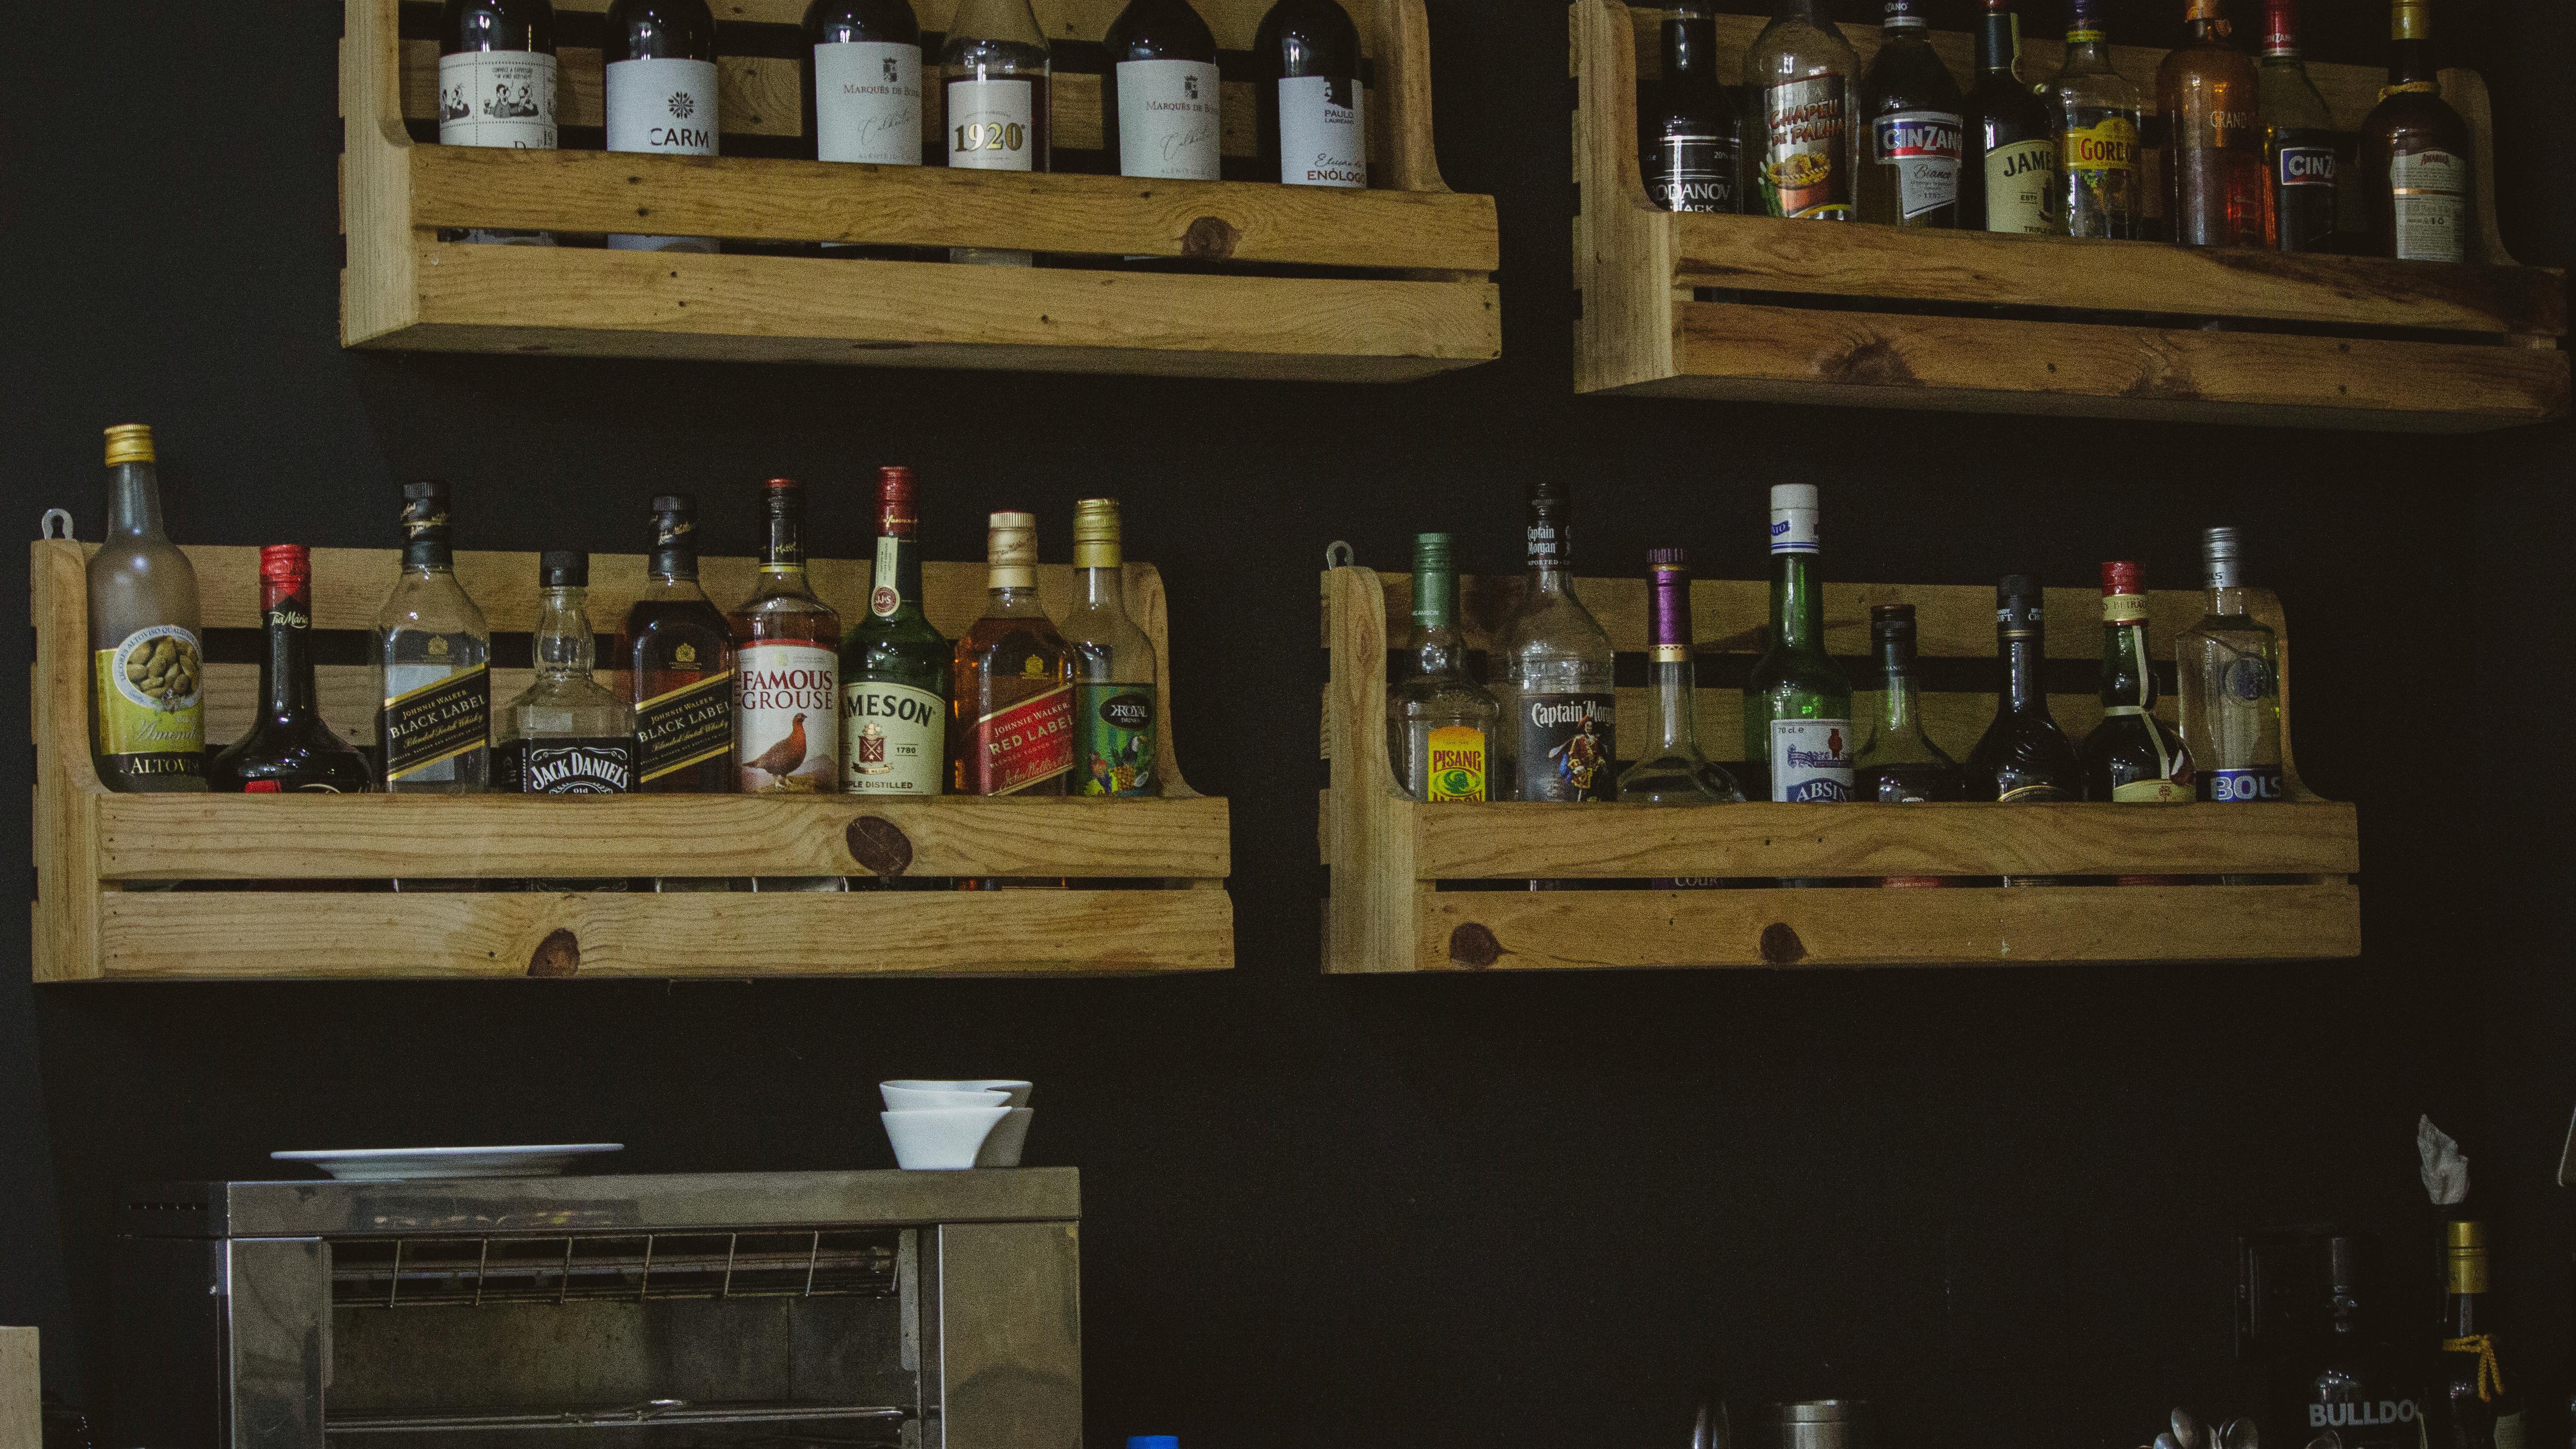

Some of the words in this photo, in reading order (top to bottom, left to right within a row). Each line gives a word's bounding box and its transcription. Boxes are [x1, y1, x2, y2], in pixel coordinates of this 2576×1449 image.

[1324, 110, 1354, 118] PAULO
[650, 128, 709, 148] CARM
[954, 122, 1023, 153] 1920
[1527, 525, 1555, 542] Captain
[1527, 541, 1556, 557] Morgan
[741, 670, 833, 690] FAMOUS
[402, 701, 436, 720] JOHNNIE
[436, 689, 468, 705] WALKER
[651, 706, 684, 724] JOHNNIE
[684, 696, 715, 711] WALKER
[741, 691, 832, 710] GROUSE
[389, 712, 439, 739] BLACK
[441, 694, 485, 719] LABEL
[638, 717, 686, 743] BLACK
[690, 701, 730, 725] LABEL
[994, 715, 1033, 738] JOHNNIE
[1033, 702, 1068, 721] WALKER
[1531, 701, 1583, 728] Captain
[988, 734, 1023, 756] RED
[1026, 714, 1074, 742] LABEL
[530, 758, 571, 790] JACK
[571, 752, 630, 789] DANIEL'S
[1433, 750, 1481, 773] PISANG
[2211, 775, 2282, 801] BOLS
